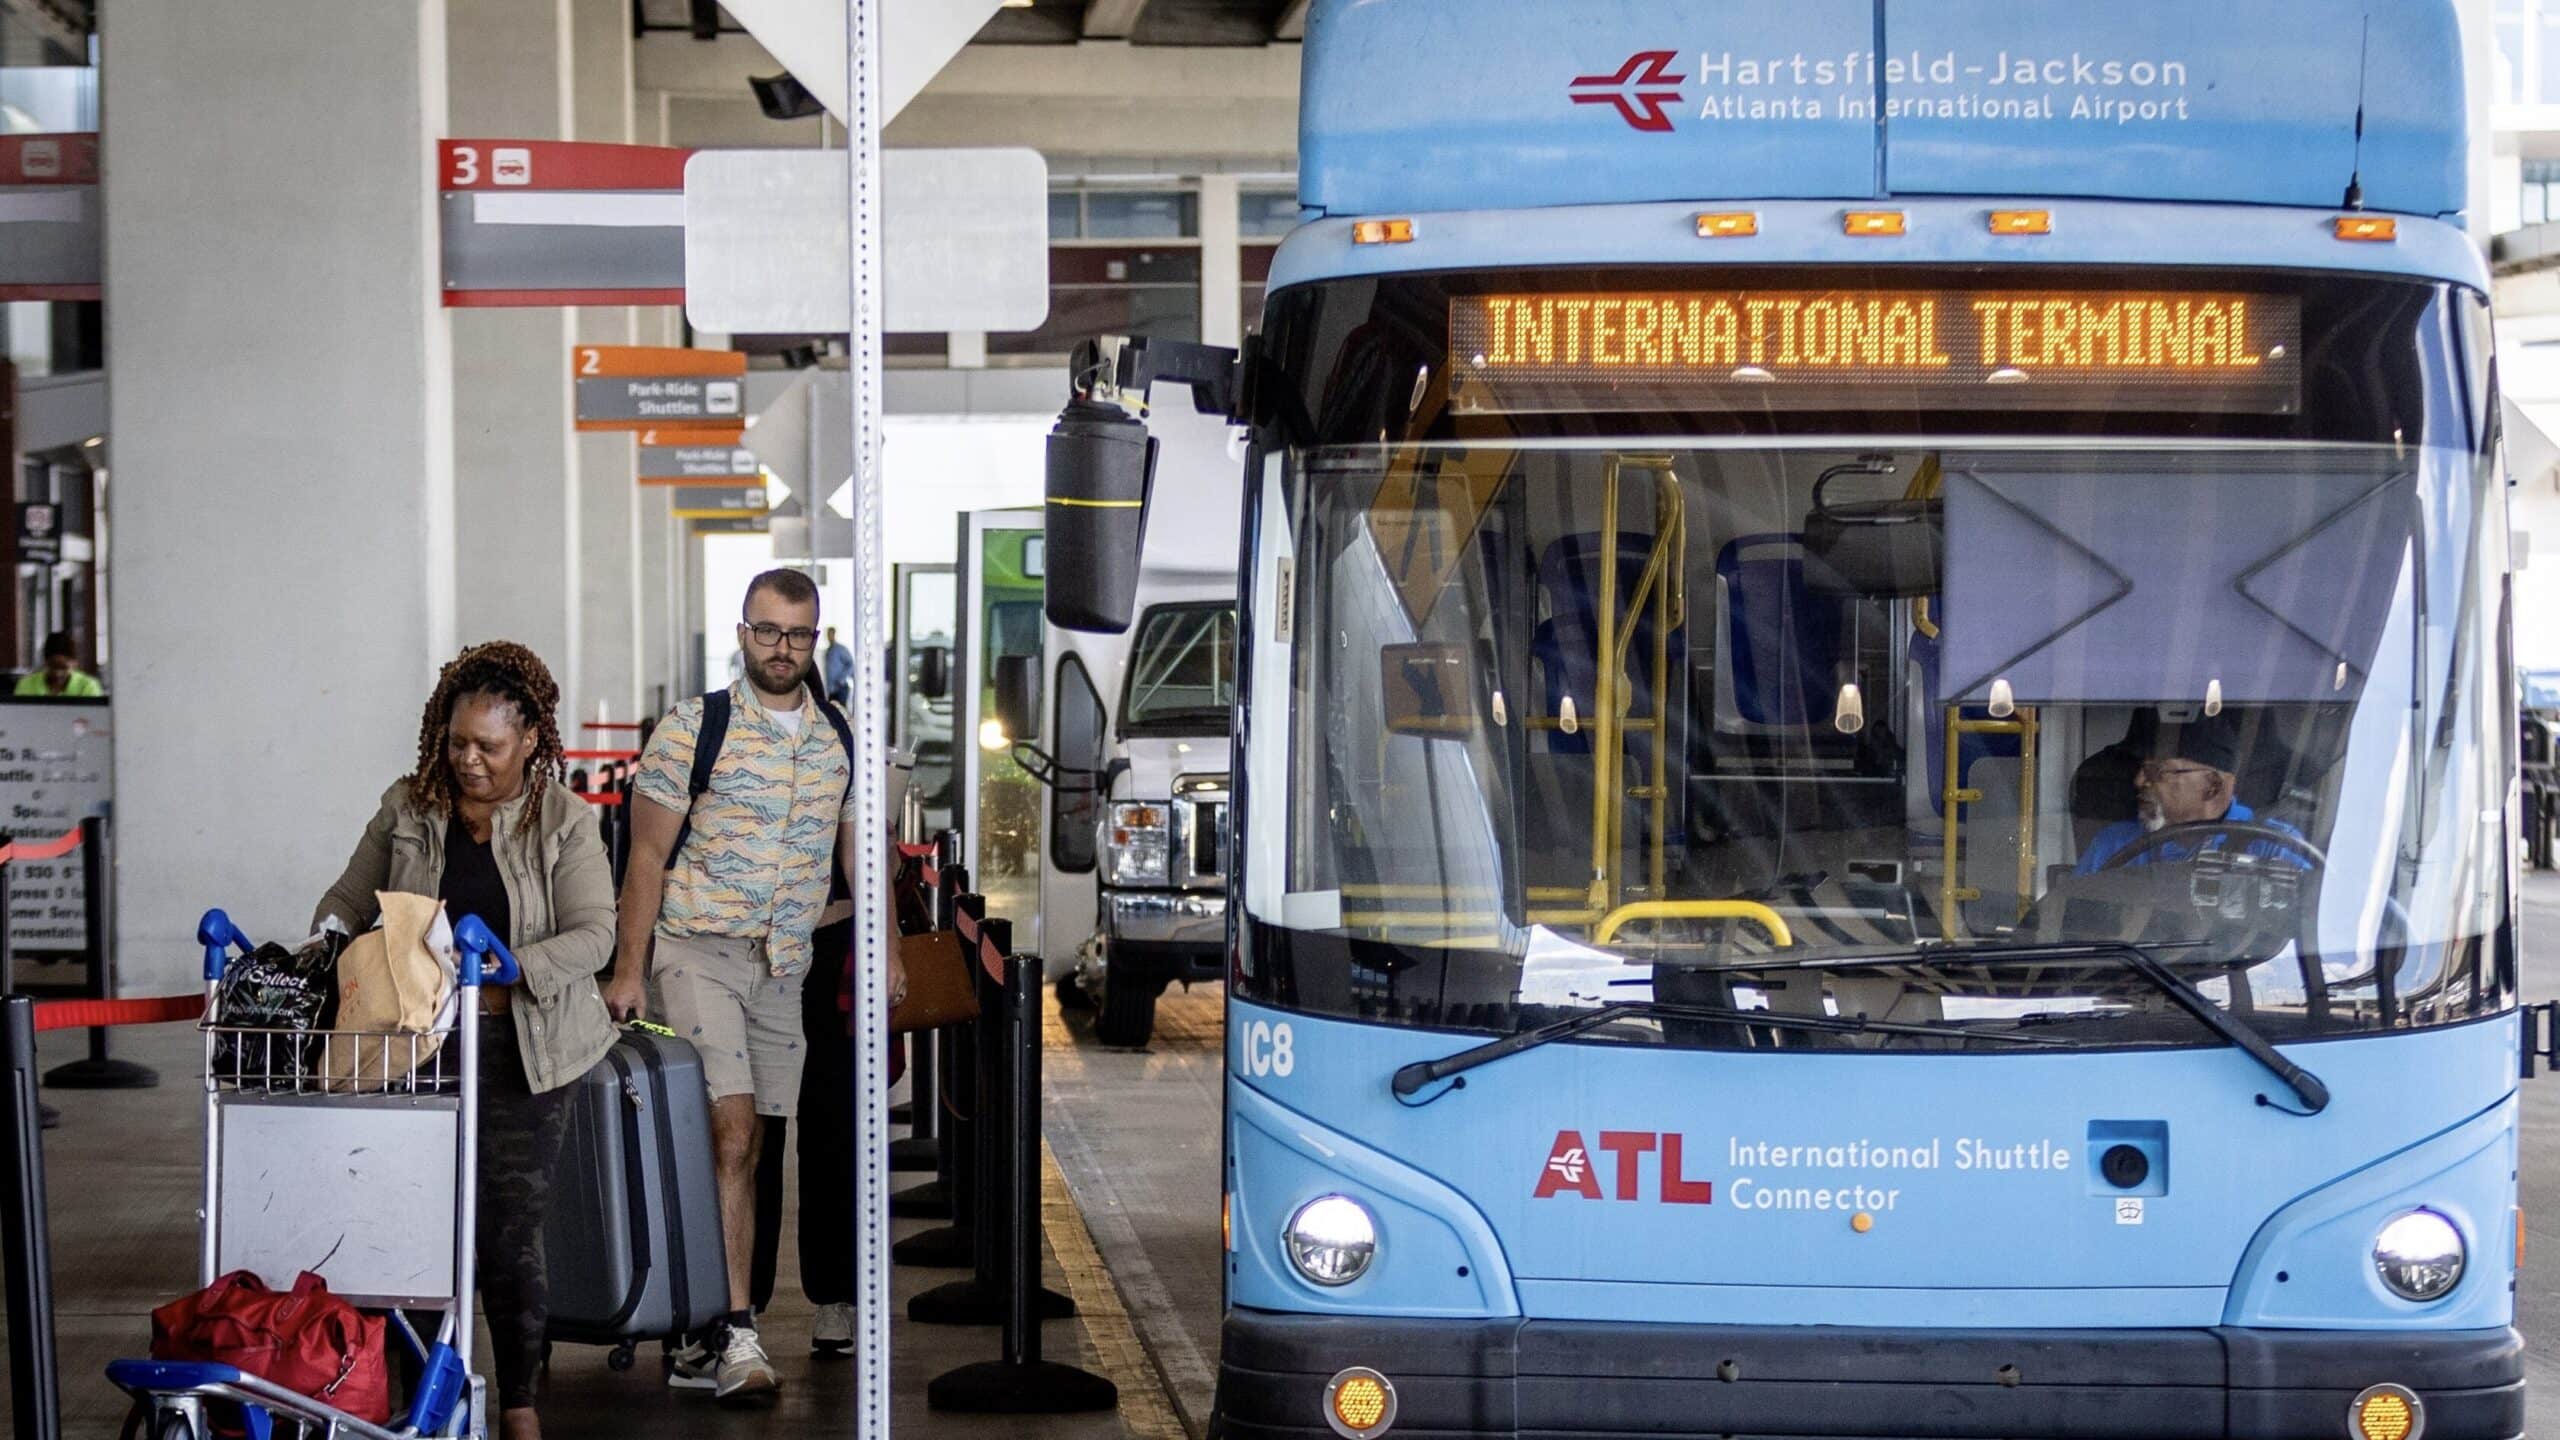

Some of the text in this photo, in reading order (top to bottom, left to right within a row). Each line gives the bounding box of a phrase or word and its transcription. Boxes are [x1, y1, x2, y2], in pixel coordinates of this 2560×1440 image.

[1700, 51, 2187, 86] Hartsfield-Jackson
[1700, 93, 2189, 126] Atlanta International Airport
[452, 147, 479, 185] 3
[1488, 299, 2260, 365] INTERNATIONAL TERMINAL
[581, 350, 600, 375] 2
[628, 383, 699, 397] Park-Ride
[638, 400, 699, 415] Shuttles
[248, 971, 309, 993] Collect
[1242, 1020, 1294, 1077] IC8
[1532, 1130, 1713, 1205] ATL
[1729, 1136, 2071, 1171] International Shuttle
[1729, 1177, 1900, 1211] Connector
